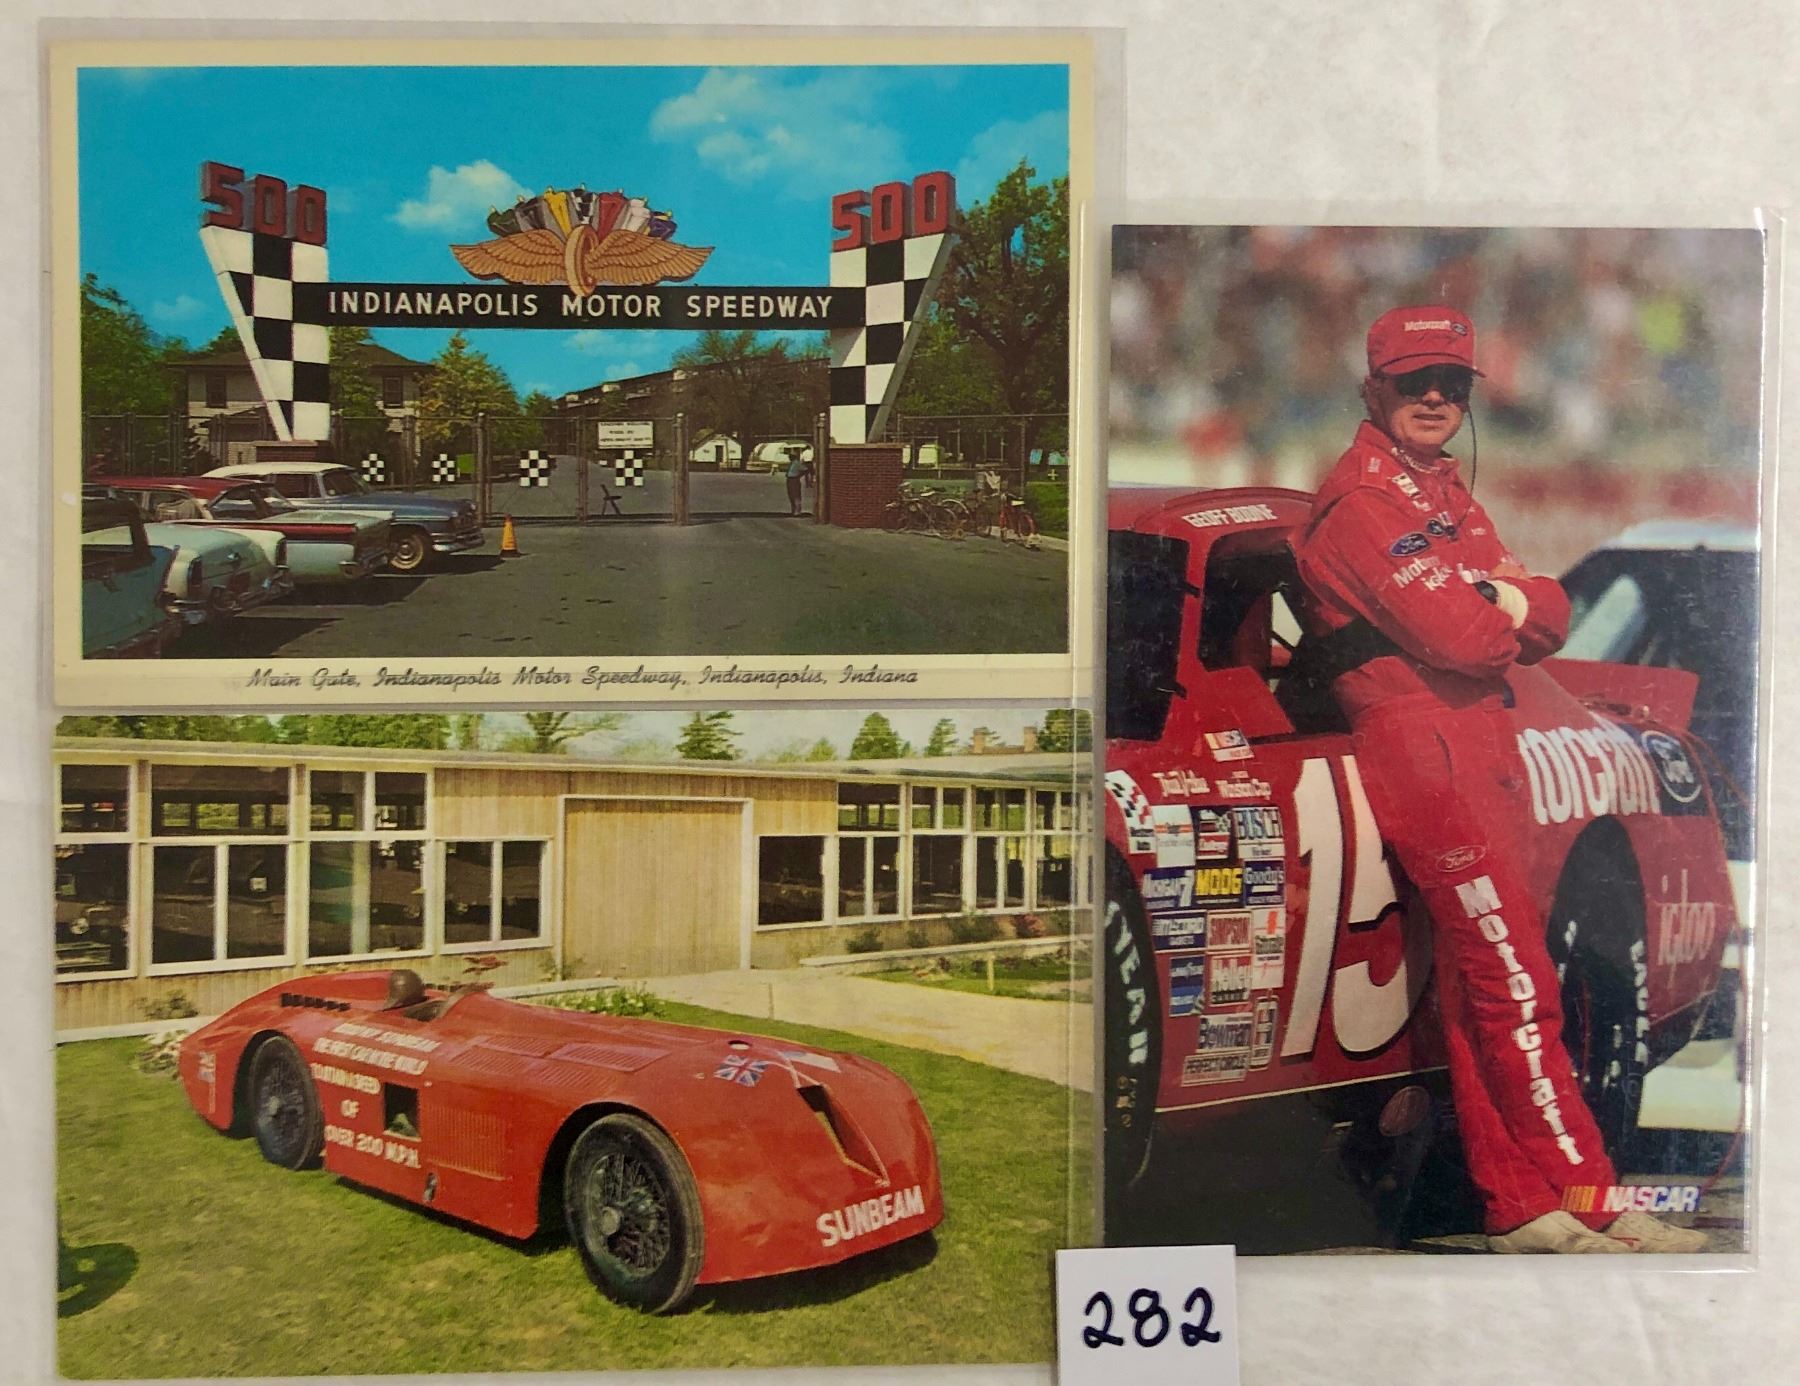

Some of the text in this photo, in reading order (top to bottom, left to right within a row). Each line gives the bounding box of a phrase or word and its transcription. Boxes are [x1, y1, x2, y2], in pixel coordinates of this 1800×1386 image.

[201, 161, 328, 246] 500
[832, 171, 957, 251] 500
[328, 291, 832, 320] INDIANAPOLIS MOTOR SPEEDWAY
[247, 665, 919, 691] Main Gate, Indianapolis Motor Speedway, Indianapolis, Indiana
[1195, 867, 1243, 896] MOOG
[1445, 851, 1478, 870] Ford
[1280, 755, 1410, 1053] 15
[1656, 868, 1716, 990] igloo
[1455, 875, 1584, 1165] Motorcraft
[816, 1185, 926, 1247] SUNBEAM
[1602, 1185, 1700, 1213] NASCAR
[1083, 1286, 1223, 1348] 282
